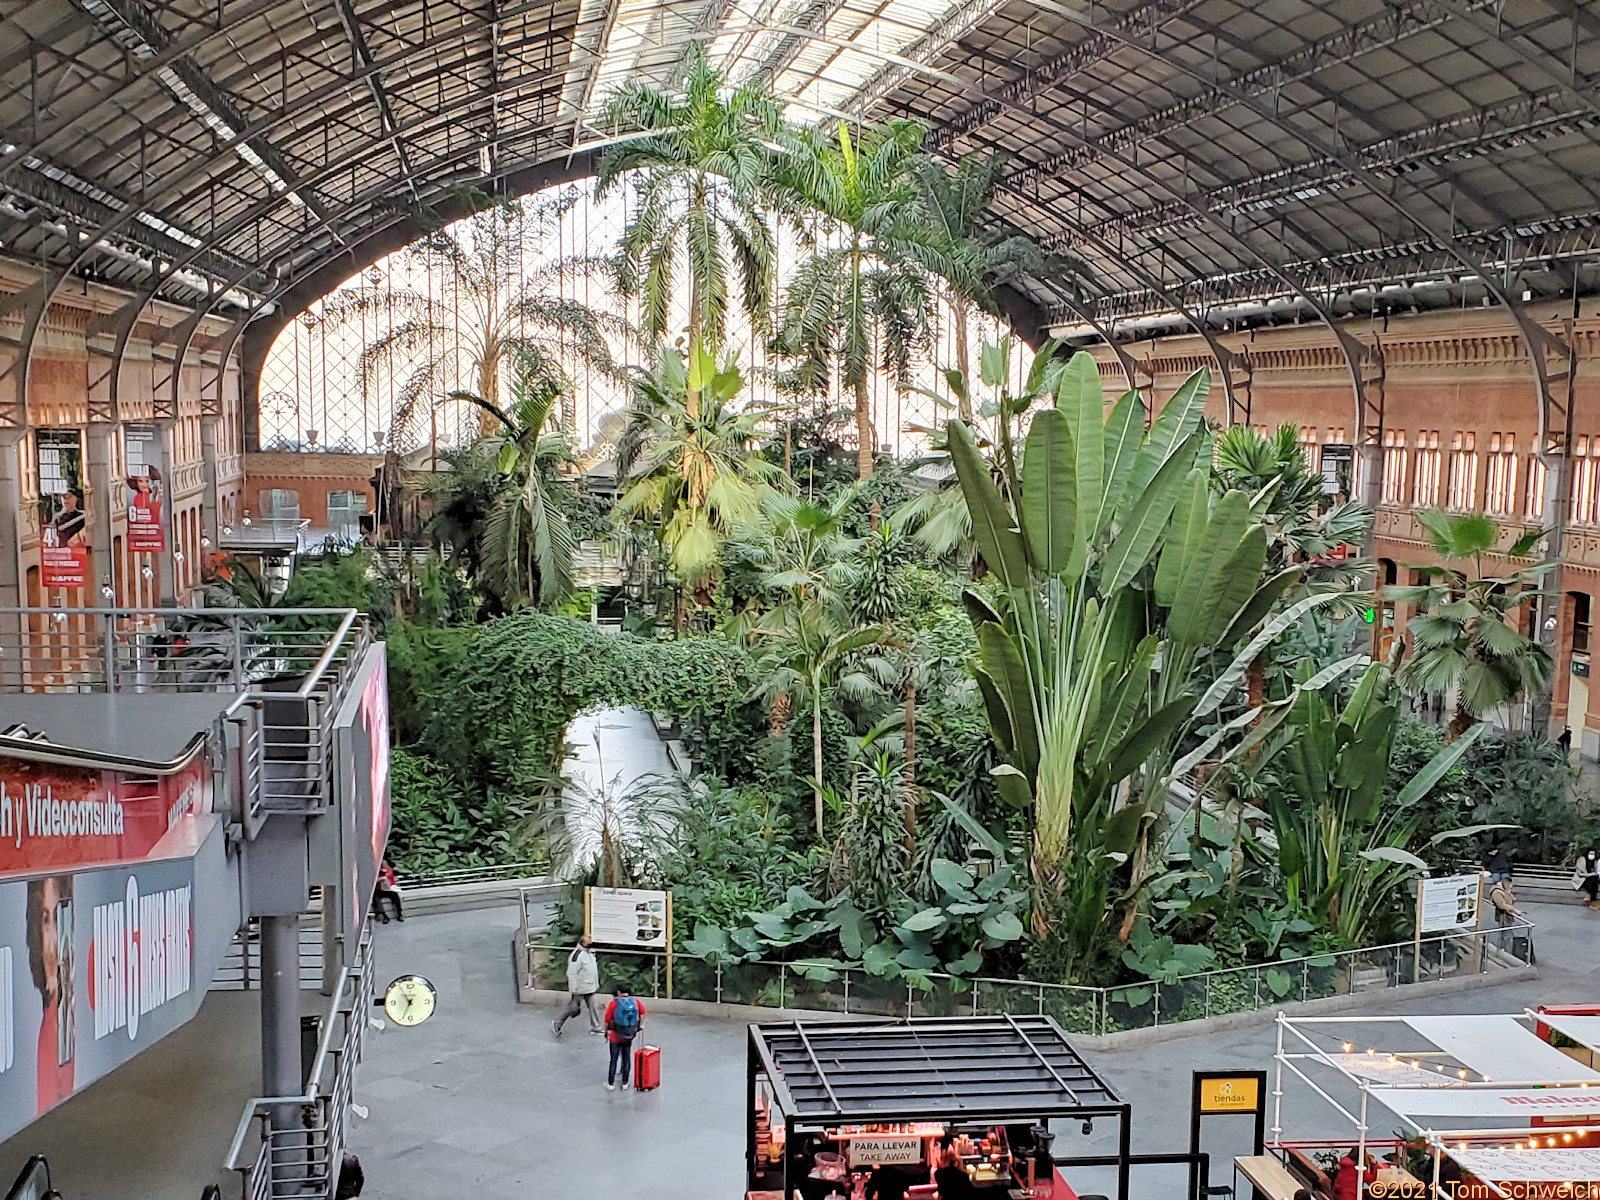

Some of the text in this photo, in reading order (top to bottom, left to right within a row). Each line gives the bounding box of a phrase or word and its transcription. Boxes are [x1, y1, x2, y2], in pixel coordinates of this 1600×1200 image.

[0, 781, 13, 837] h
[16, 801, 23, 848] y
[25, 783, 124, 837] Videoconsulta
[126, 875, 139, 1040] 6
[855, 1141, 917, 1150] PARA LLEVAR
[860, 1152, 911, 1161] TAKE AWAY
